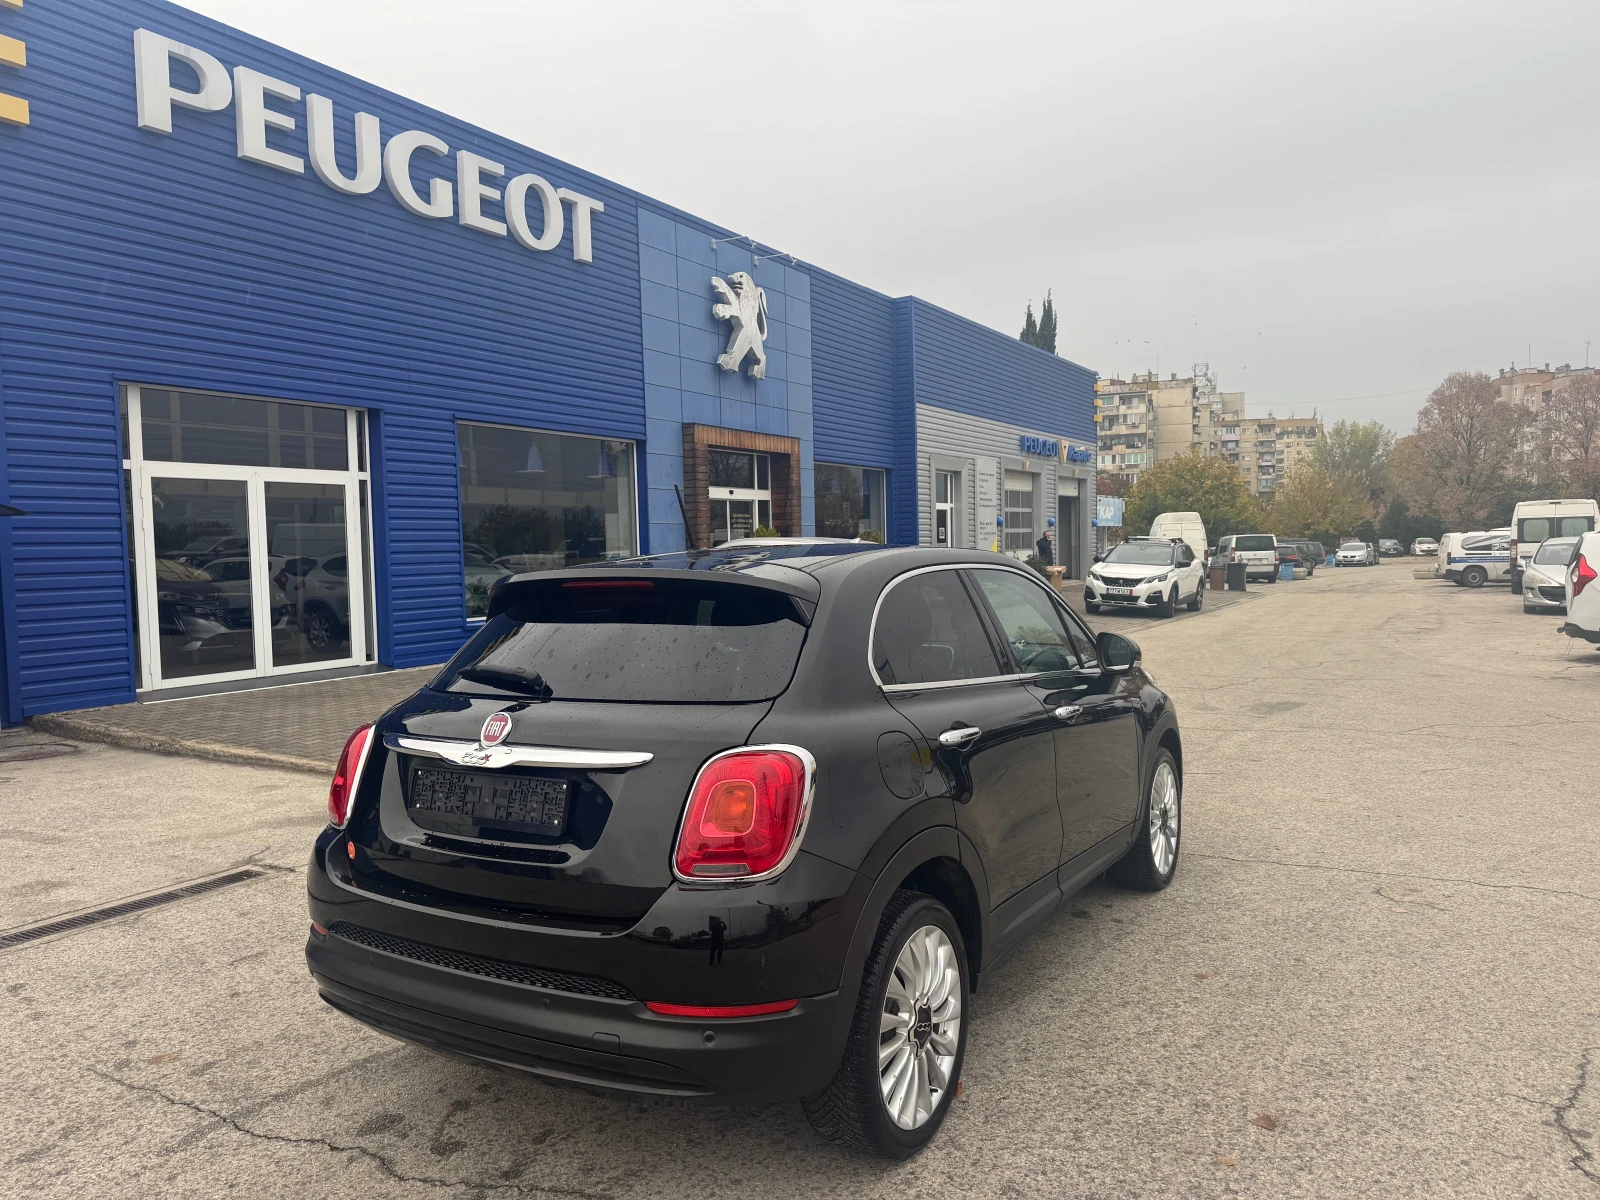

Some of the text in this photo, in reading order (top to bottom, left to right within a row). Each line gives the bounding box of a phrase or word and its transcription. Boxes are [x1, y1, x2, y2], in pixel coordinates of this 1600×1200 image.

[133, 28, 605, 263] PEUGEOT
[1021, 436, 1058, 457] PEUGEOT
[485, 722, 505, 736] FIAT
